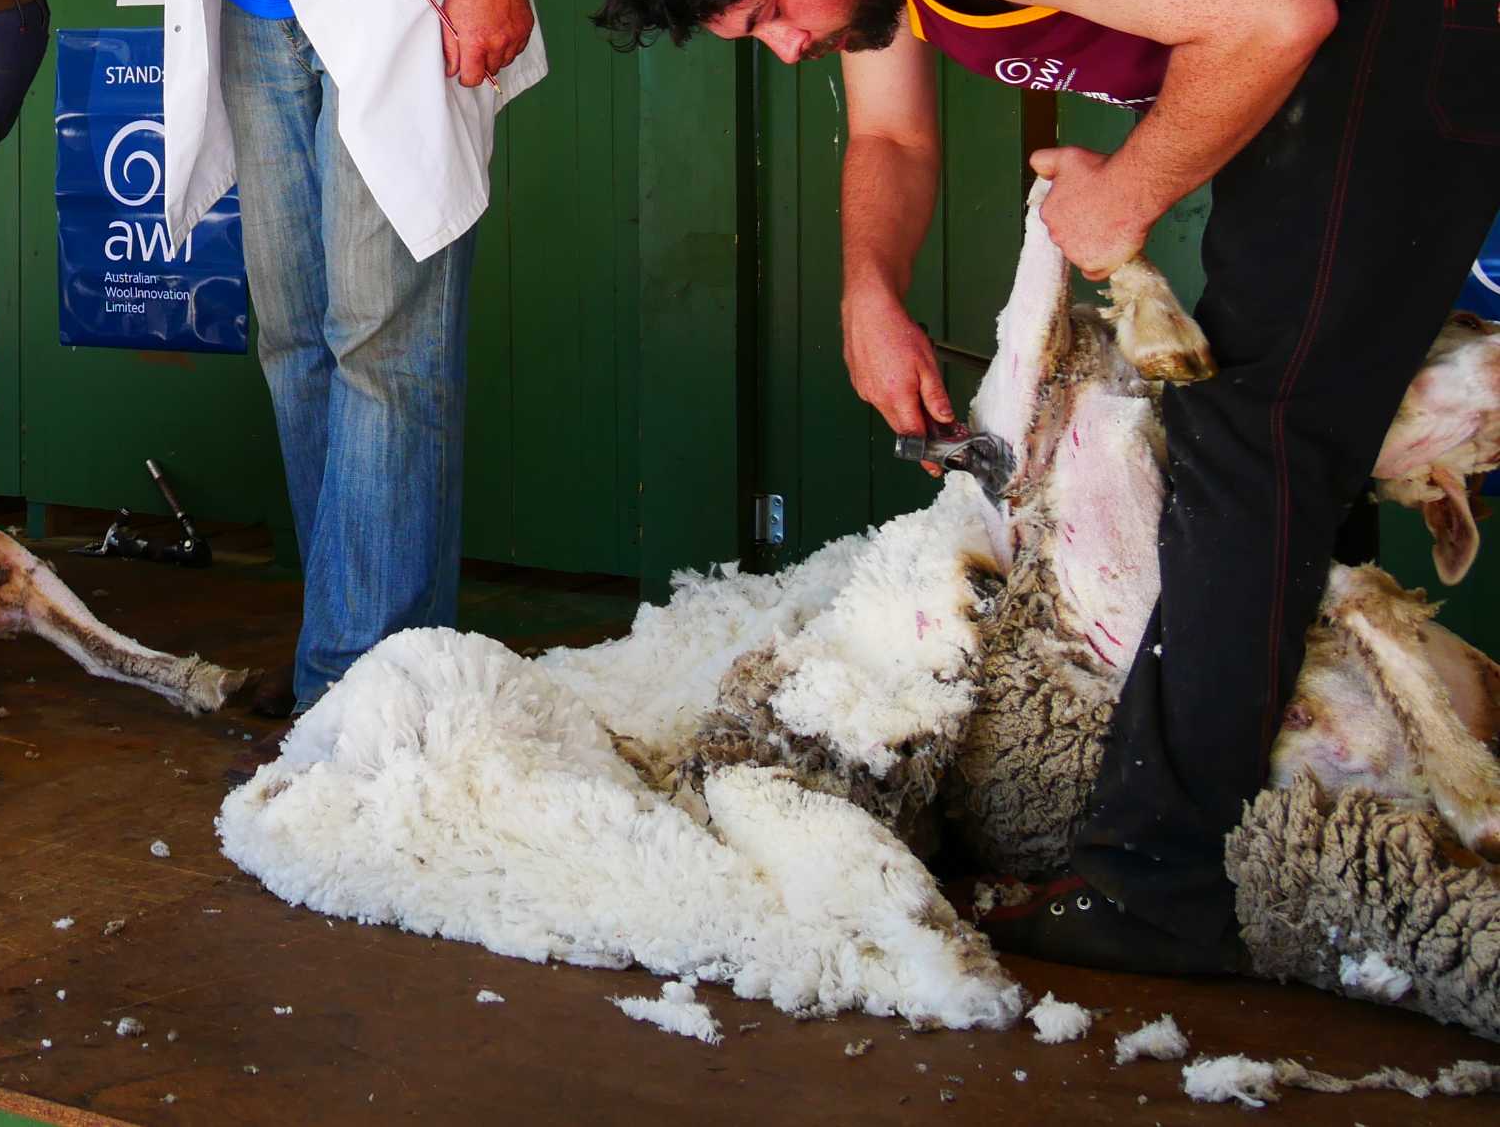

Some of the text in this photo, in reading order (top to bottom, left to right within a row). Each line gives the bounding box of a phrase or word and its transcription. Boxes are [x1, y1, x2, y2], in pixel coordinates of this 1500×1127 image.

[104, 270, 158, 285] Australian
[105, 285, 191, 302] Wool Innovation
[105, 301, 146, 315] Limited
